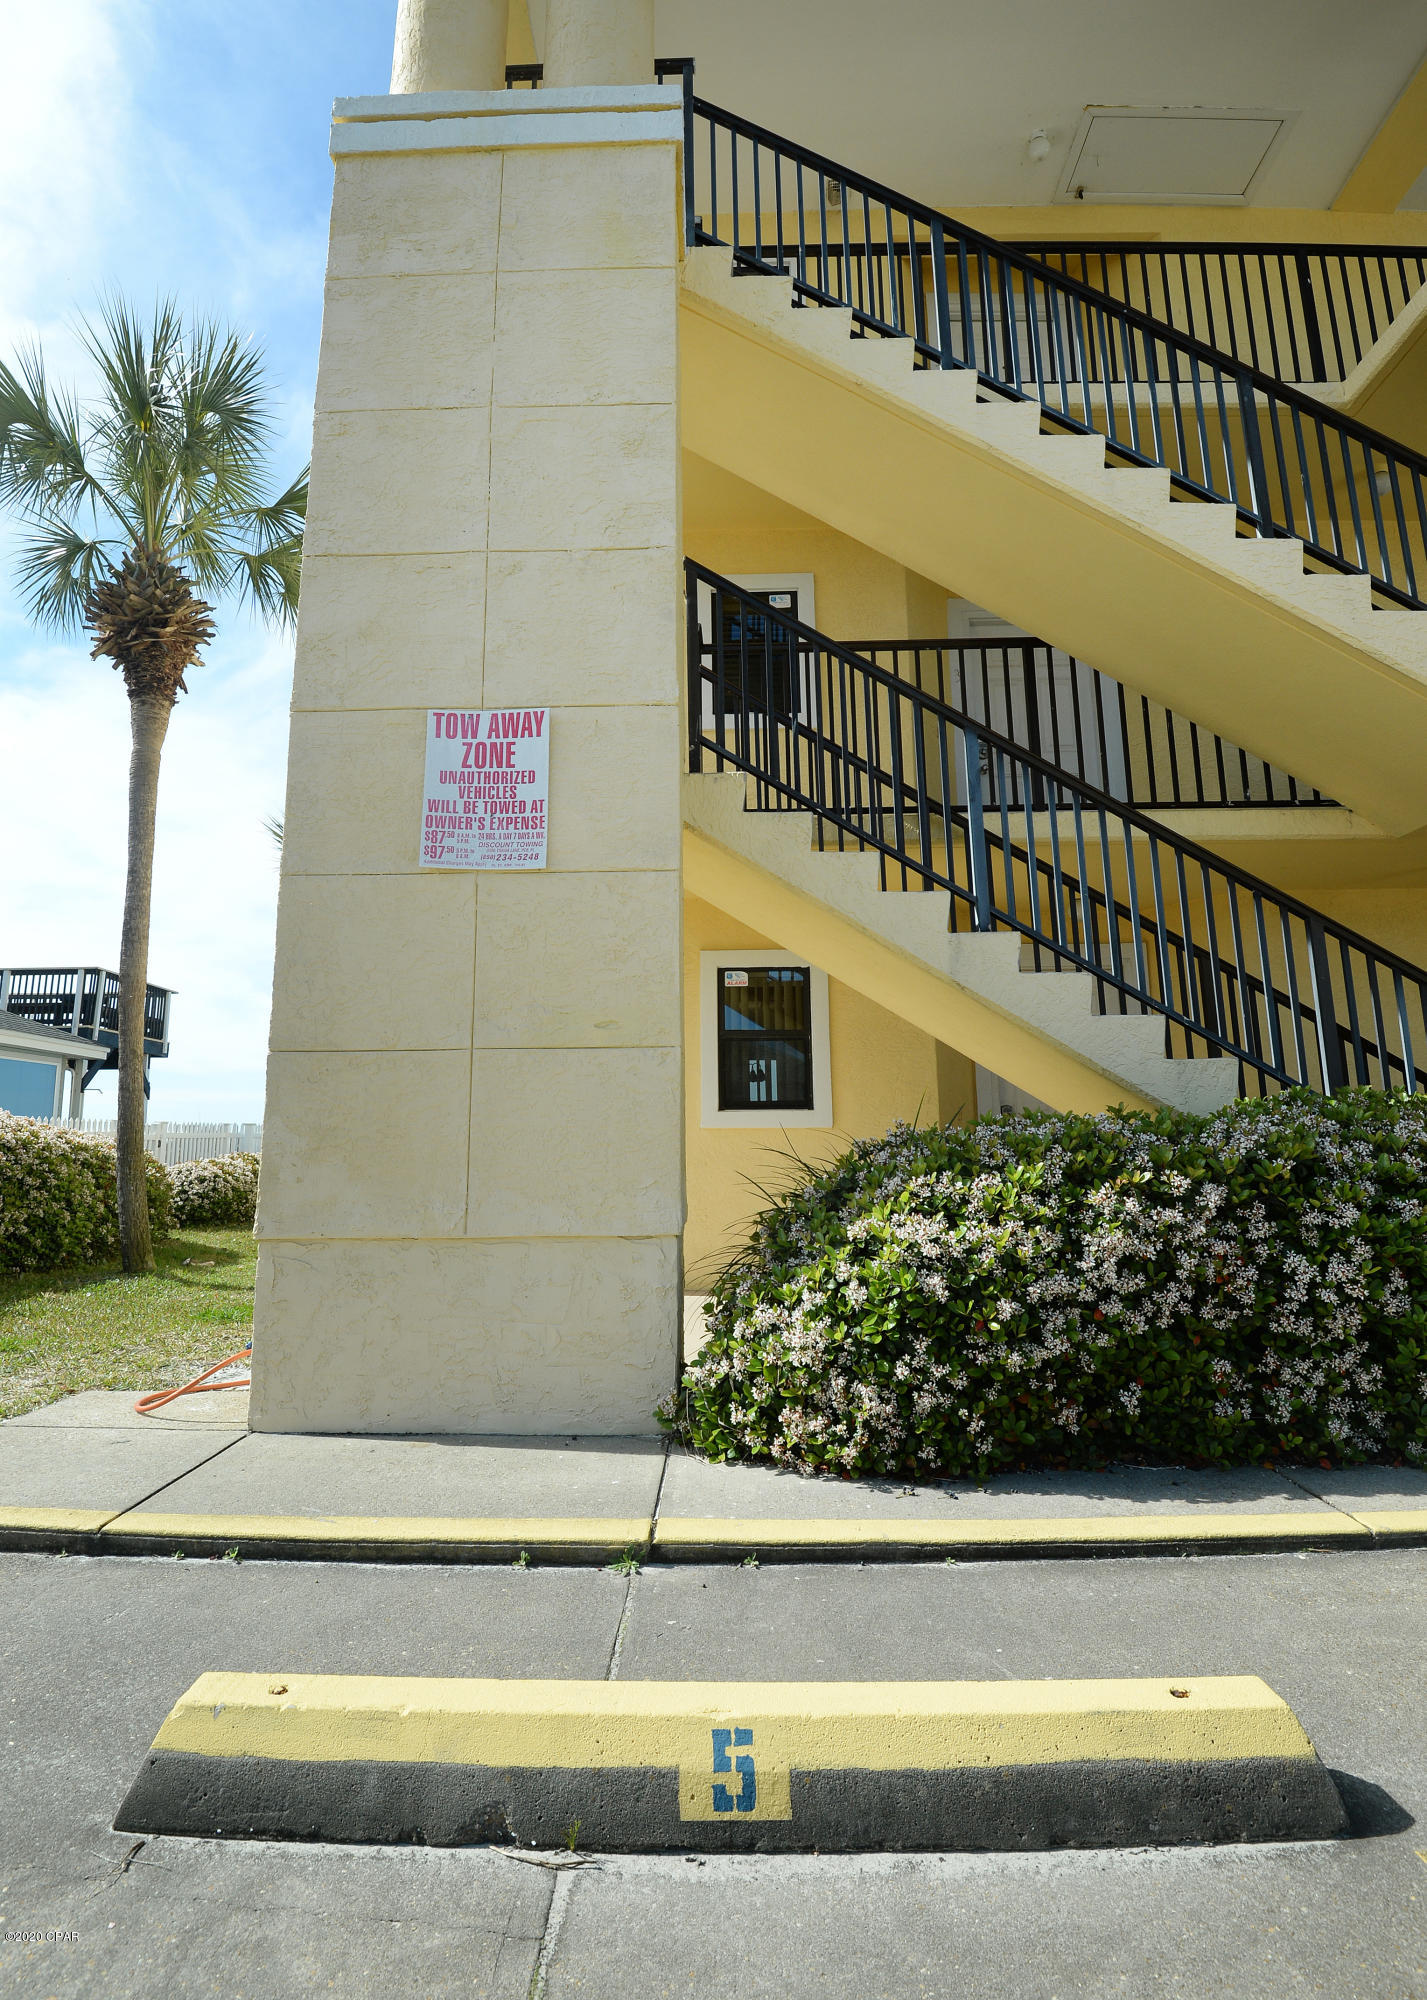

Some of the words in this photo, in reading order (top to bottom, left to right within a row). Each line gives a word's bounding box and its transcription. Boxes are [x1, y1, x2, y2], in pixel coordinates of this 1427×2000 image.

[433, 712, 480, 739] TOW
[487, 710, 545, 739] AWAY
[461, 741, 516, 769] ZONE
[439, 770, 536, 784] UNAUTHORIZED
[458, 785, 517, 799] VEHICLES
[427, 799, 459, 814] WILL
[463, 800, 478, 814] BE
[483, 800, 527, 815] TOWED
[530, 799, 545, 814] AT
[425, 814, 485, 830] OWNER'S
[489, 815, 545, 830] EXPENSE
[503, 832, 512, 840] DAY
[518, 832, 530, 840] DAYS
[496, 853, 540, 861] 234-5248
[711, 1727, 757, 1812] 5
